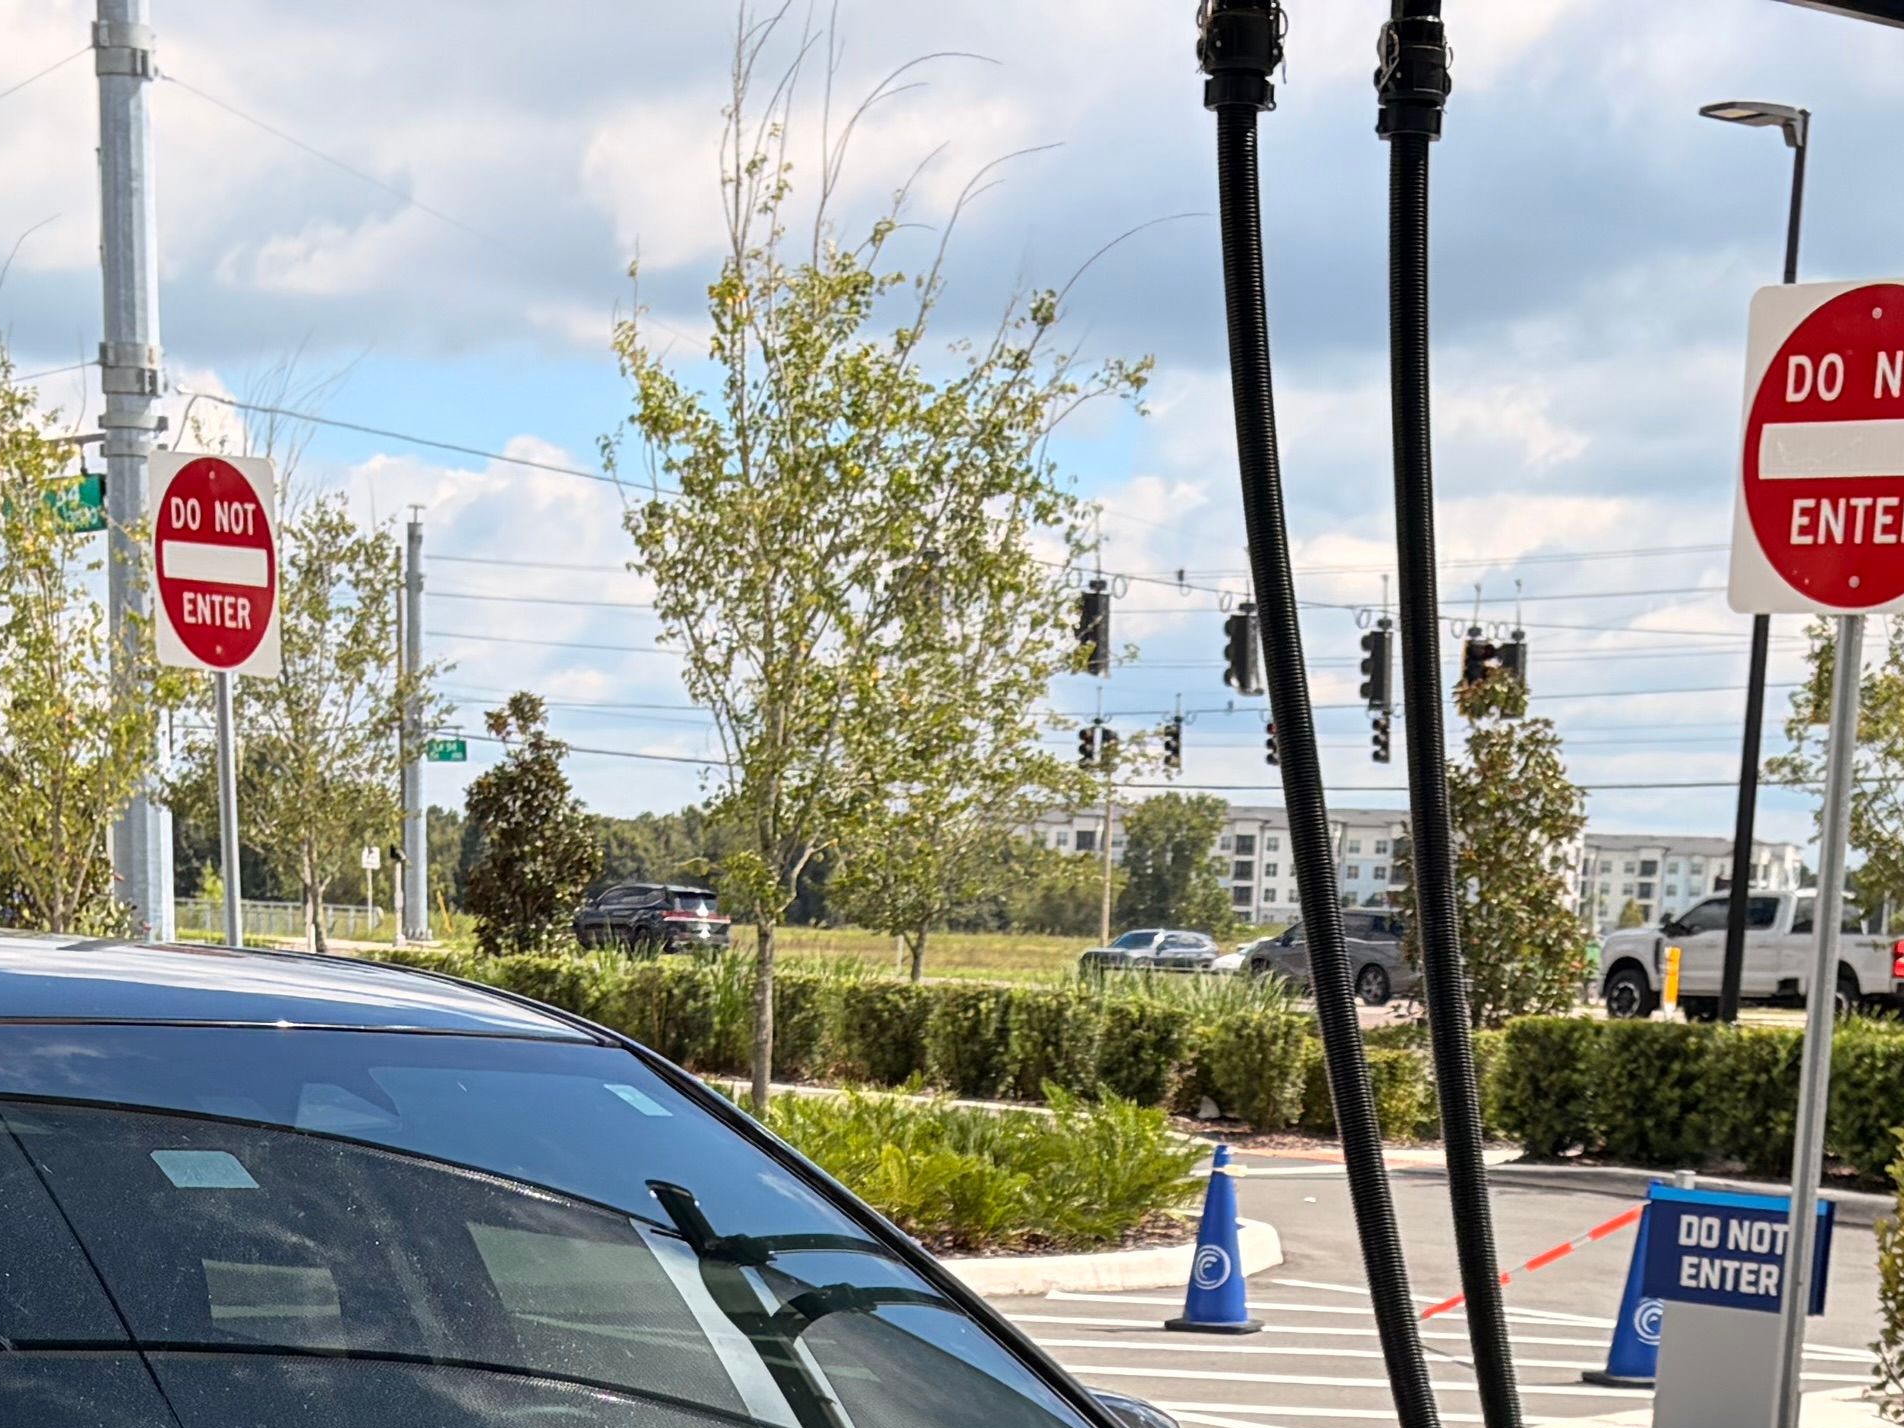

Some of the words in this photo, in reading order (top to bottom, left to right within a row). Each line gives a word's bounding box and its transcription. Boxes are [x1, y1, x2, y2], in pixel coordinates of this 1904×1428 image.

[1785, 353, 1844, 403] DO
[170, 496, 202, 531] DO
[214, 500, 256, 536] NOT
[182, 591, 252, 630] ENTER
[1678, 1214, 1721, 1249] DO
[1727, 1218, 1791, 1256] NOT
[1679, 1255, 1780, 1297] ENTER
